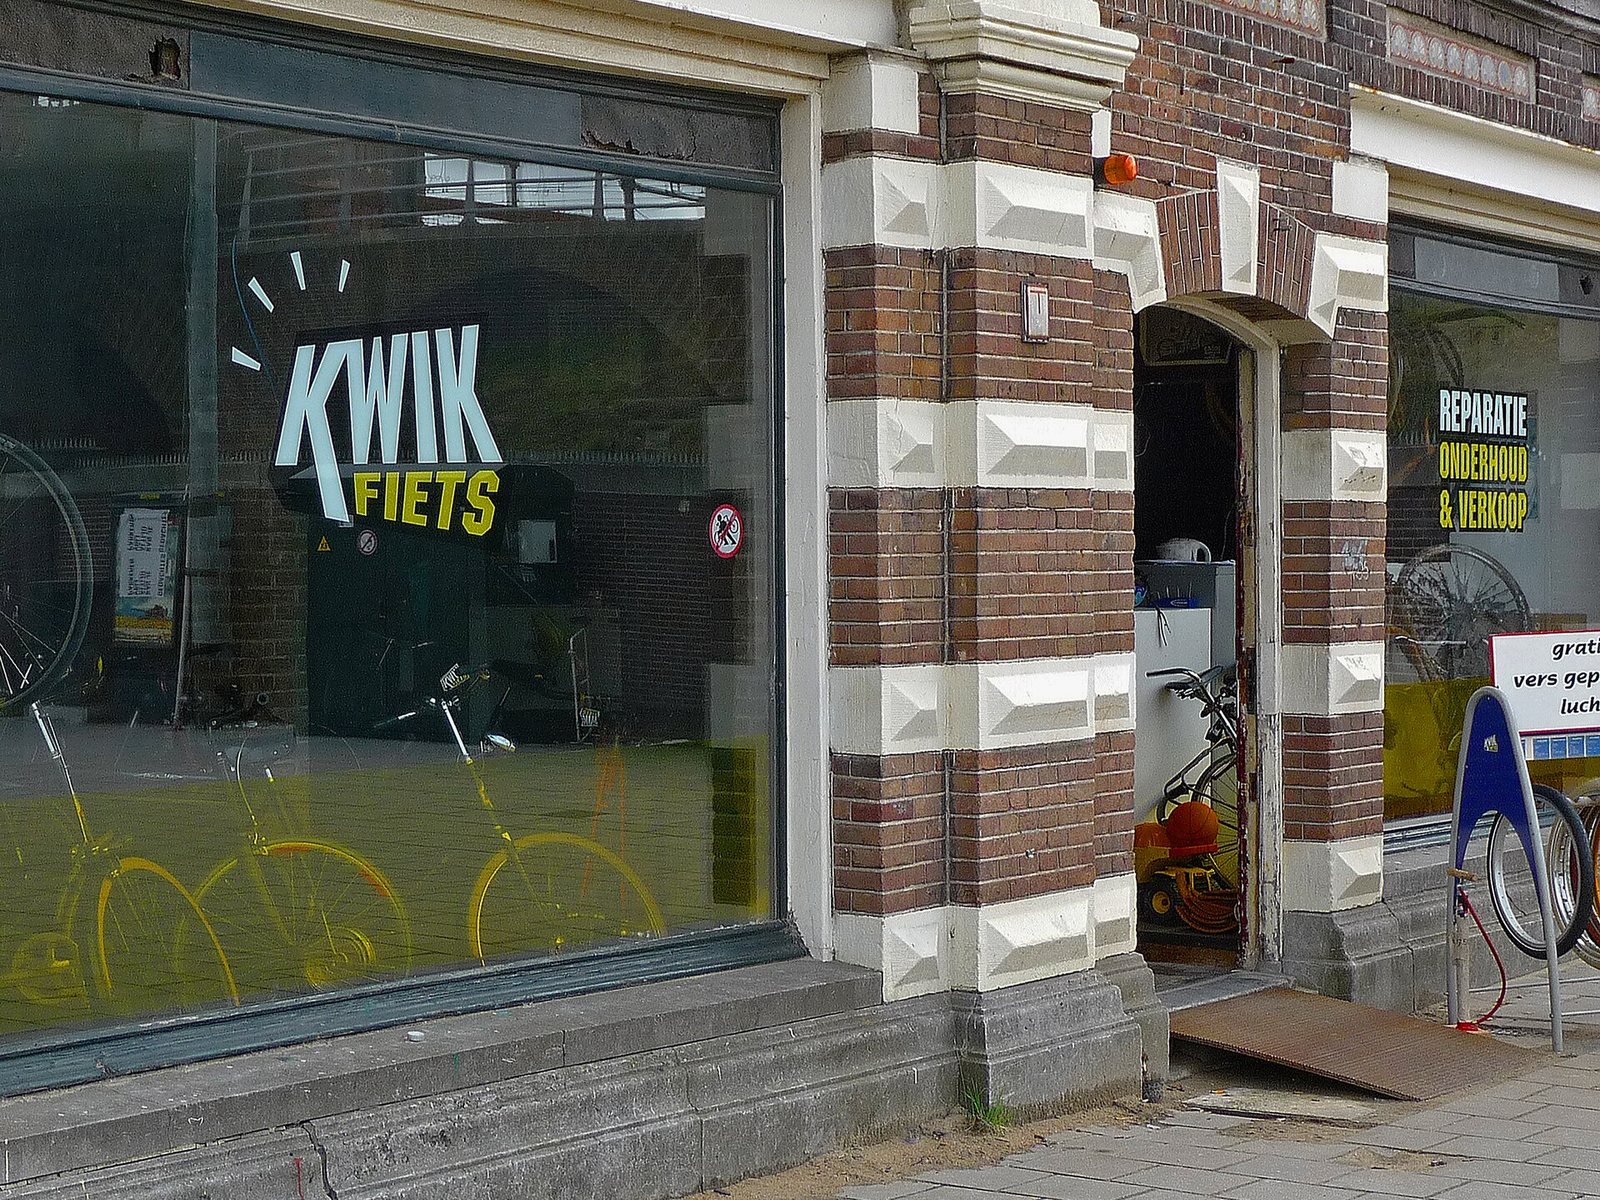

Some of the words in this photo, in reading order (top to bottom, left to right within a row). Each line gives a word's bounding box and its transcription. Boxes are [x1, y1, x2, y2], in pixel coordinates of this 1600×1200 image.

[275, 324, 503, 523] KWIK
[1439, 389, 1528, 437] REPARATIE
[1439, 441, 1528, 482] ONDERHOUD
[354, 470, 500, 536] FIETS
[1439, 489, 1454, 529] &
[1458, 490, 1528, 530] VERKOOP
[1552, 638, 1600, 660] grati
[1514, 674, 1558, 687] vers
[1564, 671, 1600, 689] gep
[1560, 696, 1600, 714] luch
